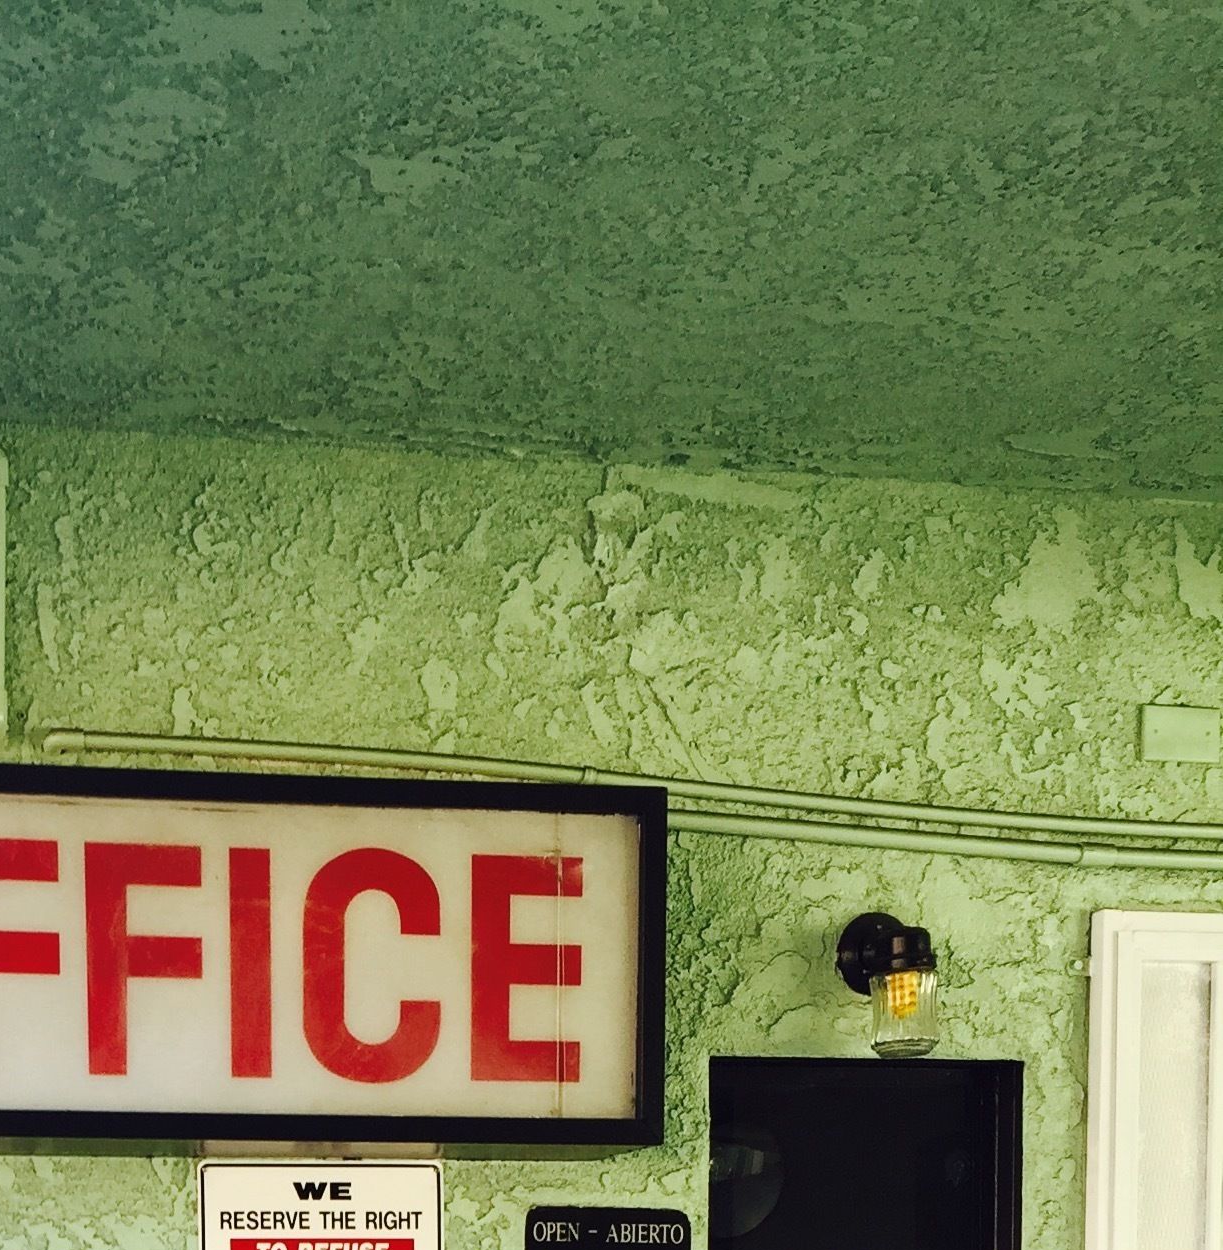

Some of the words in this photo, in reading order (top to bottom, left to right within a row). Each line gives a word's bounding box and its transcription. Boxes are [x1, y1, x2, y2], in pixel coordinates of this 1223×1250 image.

[293, 1182, 351, 1200] WE
[220, 1211, 310, 1230] RESERVE
[319, 1211, 355, 1229] THE
[366, 1211, 422, 1230] RIGHT
[533, 1222, 579, 1241] OPEN
[606, 1224, 683, 1244] ABIERTO
